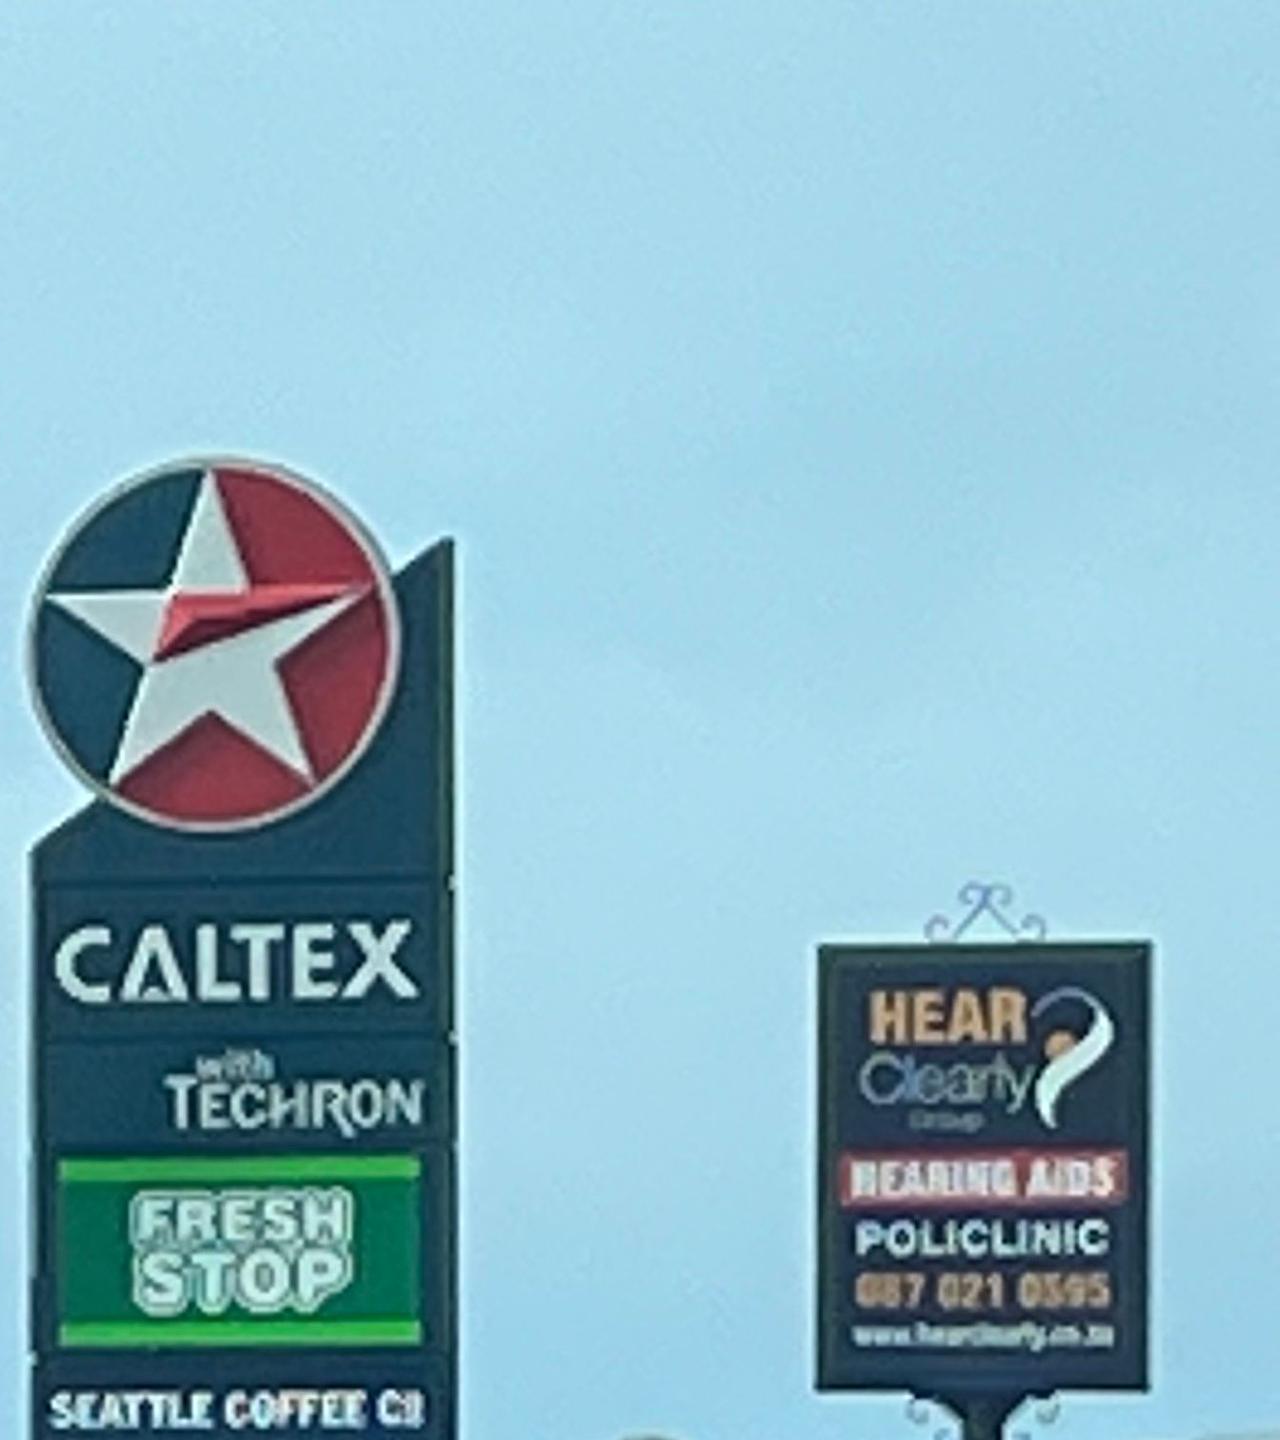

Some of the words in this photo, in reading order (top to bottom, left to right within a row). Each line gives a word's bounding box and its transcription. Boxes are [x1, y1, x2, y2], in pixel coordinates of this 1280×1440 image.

[54, 920, 421, 1003] CALTEX
[869, 986, 1029, 1046] HEAR
[196, 1049, 274, 1080] with
[859, 1051, 1038, 1115] Clearly
[163, 1073, 426, 1138] TECHRON
[850, 1160, 1018, 1198] HEARING
[1025, 1156, 1117, 1197] AIDS
[132, 1190, 352, 1246] FRESH
[855, 1219, 1110, 1257] POLICLINIC
[135, 1248, 352, 1315] STOP
[50, 1391, 214, 1430] SEATTLE
[225, 1390, 368, 1430] COFFEE
